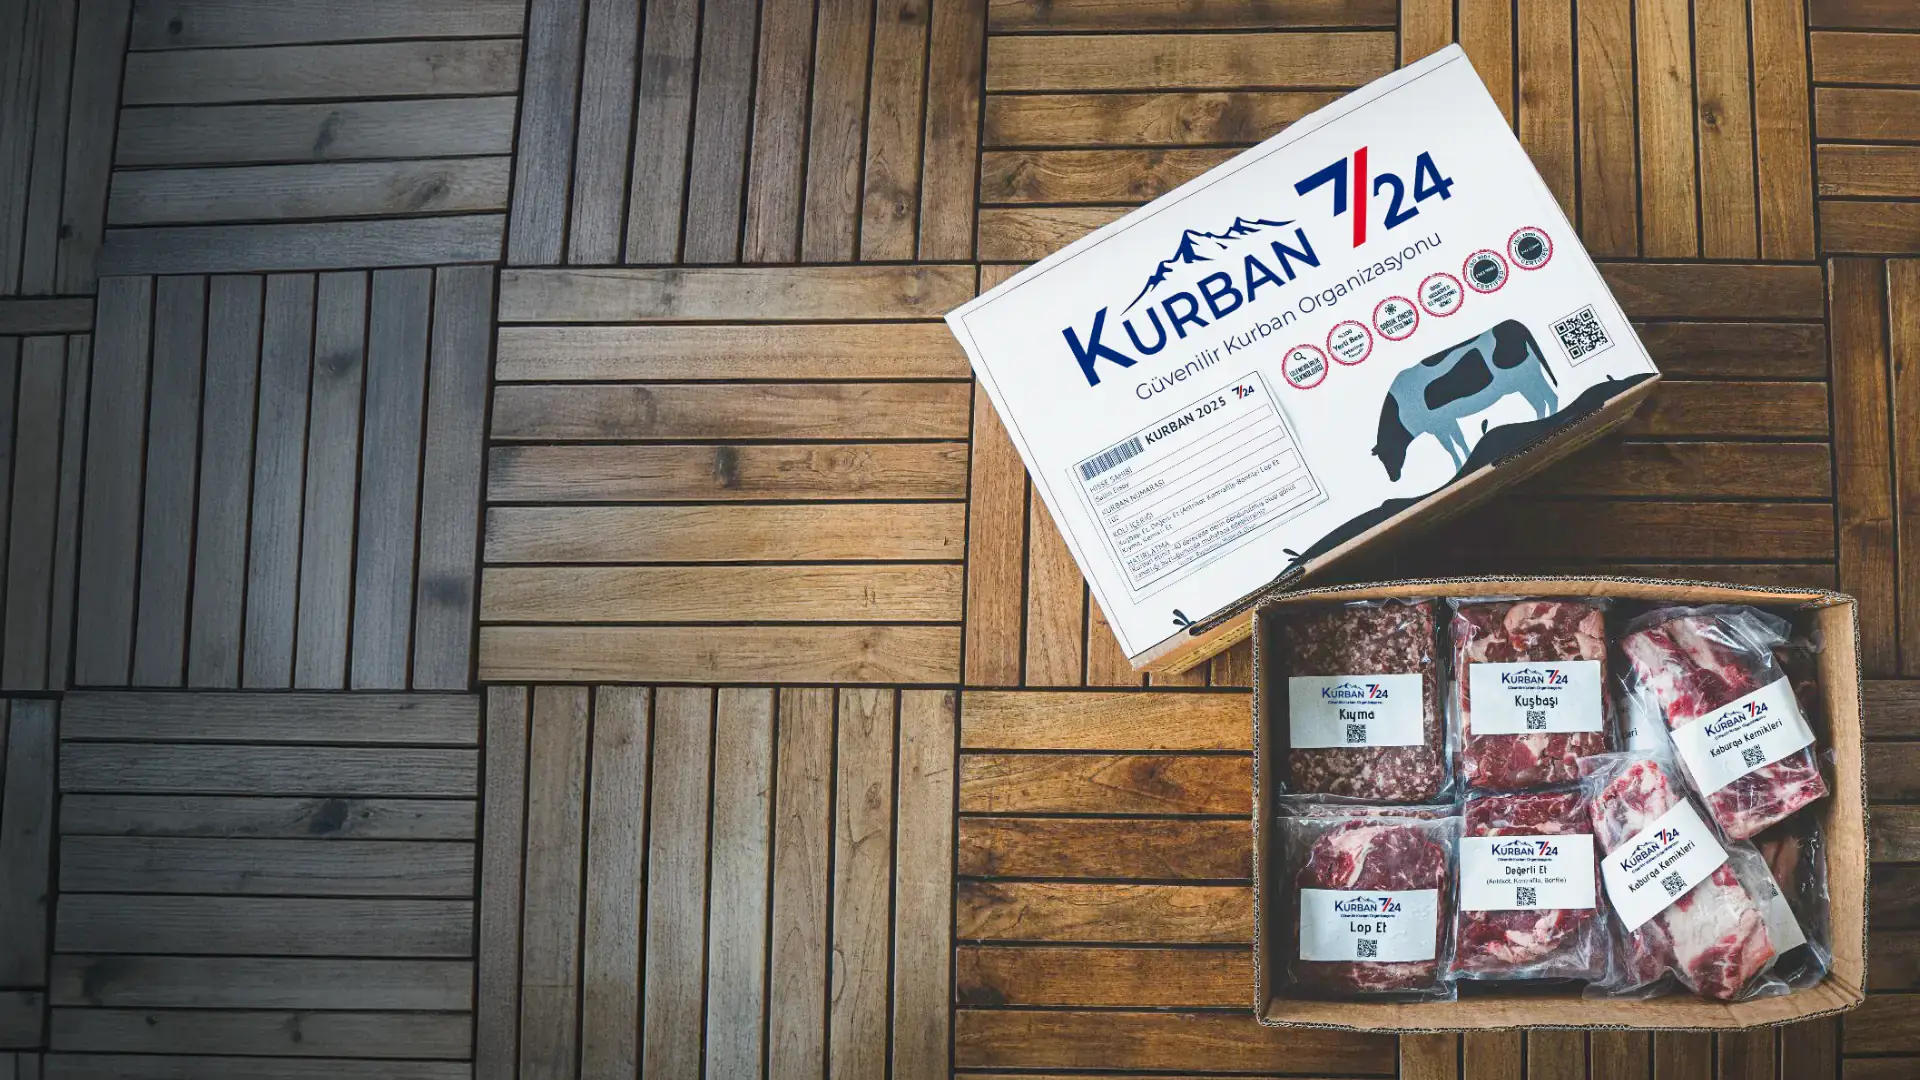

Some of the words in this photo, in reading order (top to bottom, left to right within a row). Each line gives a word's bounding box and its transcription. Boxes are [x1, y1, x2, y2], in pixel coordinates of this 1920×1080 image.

[1061, 227, 1320, 387] KURBAN
[1293, 145, 1453, 248] 7/24
[1135, 348, 1219, 399] Güvenilir
[1222, 310, 1296, 355] Kurban
[1298, 232, 1441, 313] Organizasyonu
[1332, 339, 1349, 351] Yerli
[1348, 331, 1363, 343] Besi
[1144, 412, 1194, 444] KURBAN
[1195, 396, 1226, 418] 2025
[1231, 384, 1254, 399] 7/24
[1101, 497, 1129, 515] KURBAN
[1501, 672, 1544, 684] KURBAN
[1545, 669, 1568, 684] 7/24
[1322, 687, 1364, 699] KURBAN
[1365, 684, 1388, 699] 7/24
[1514, 695, 1558, 709] Kuşbaşı
[1339, 709, 1375, 722] Kıyma
[1704, 712, 1747, 737] KURBAN
[1743, 701, 1769, 718] 7/24
[1709, 738, 1743, 758] Kaburga
[1744, 718, 1783, 743] Kemikleri
[1491, 844, 1534, 856] KURBAN
[1535, 841, 1558, 856] 7/24
[1620, 843, 1660, 872] KURBAN
[1653, 828, 1680, 846] 7/24
[1505, 866, 1536, 876] Değerli
[1539, 865, 1547, 874] Et
[1628, 868, 1660, 893] Kaburga
[1660, 840, 1696, 871] Kemikleri
[1334, 900, 1377, 912] KURBAN
[1378, 897, 1401, 912] 7/24
[1350, 921, 1372, 935] Lop
[1376, 922, 1387, 933] Et
